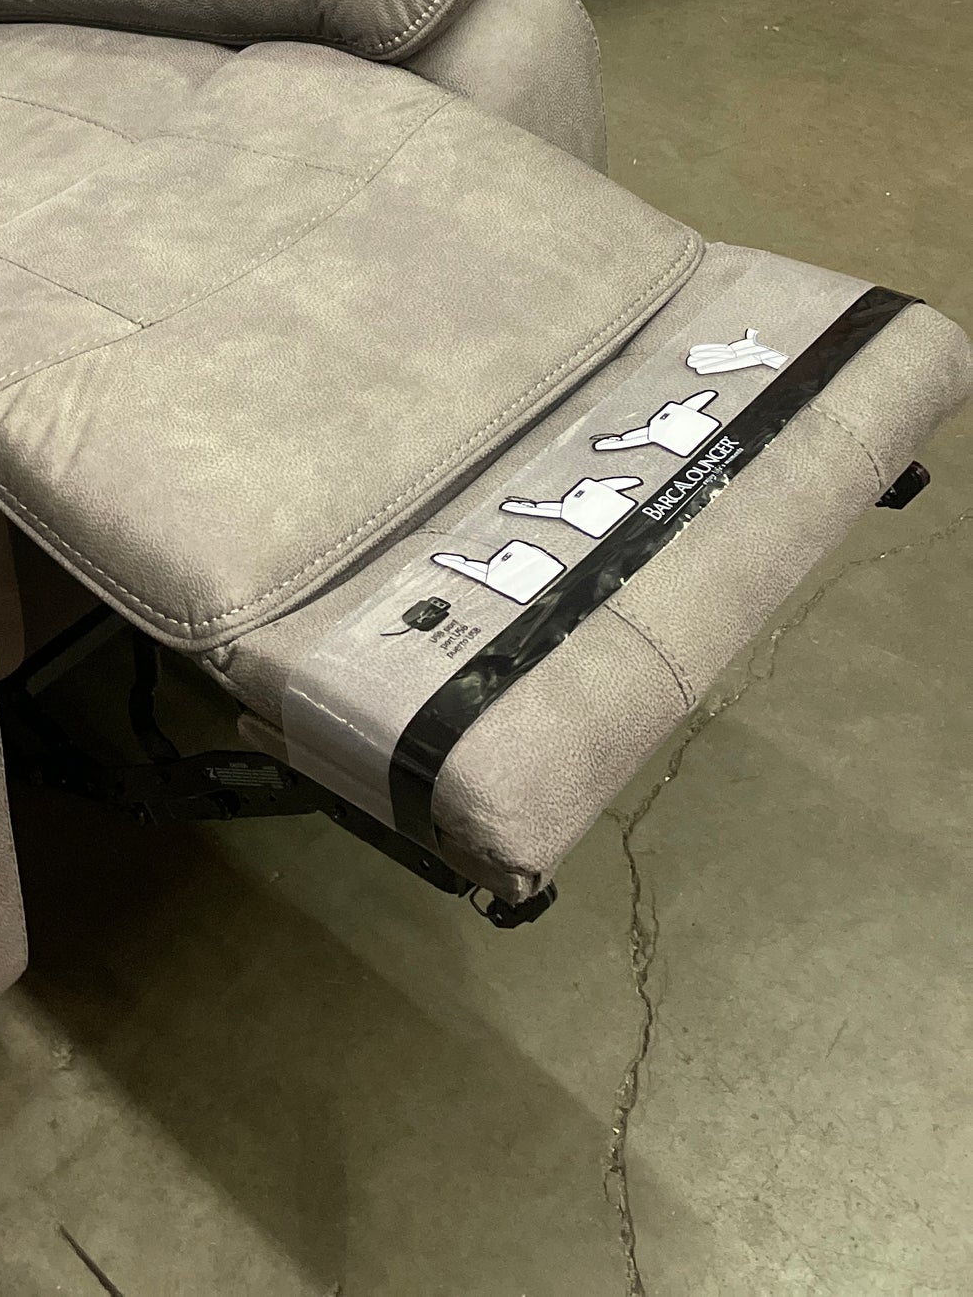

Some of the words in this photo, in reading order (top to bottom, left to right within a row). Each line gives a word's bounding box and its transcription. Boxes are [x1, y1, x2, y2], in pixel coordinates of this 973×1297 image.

[642, 436, 740, 521] BARCALOUNGER
[447, 638, 469, 660] puerto
[466, 627, 482, 640] USB
